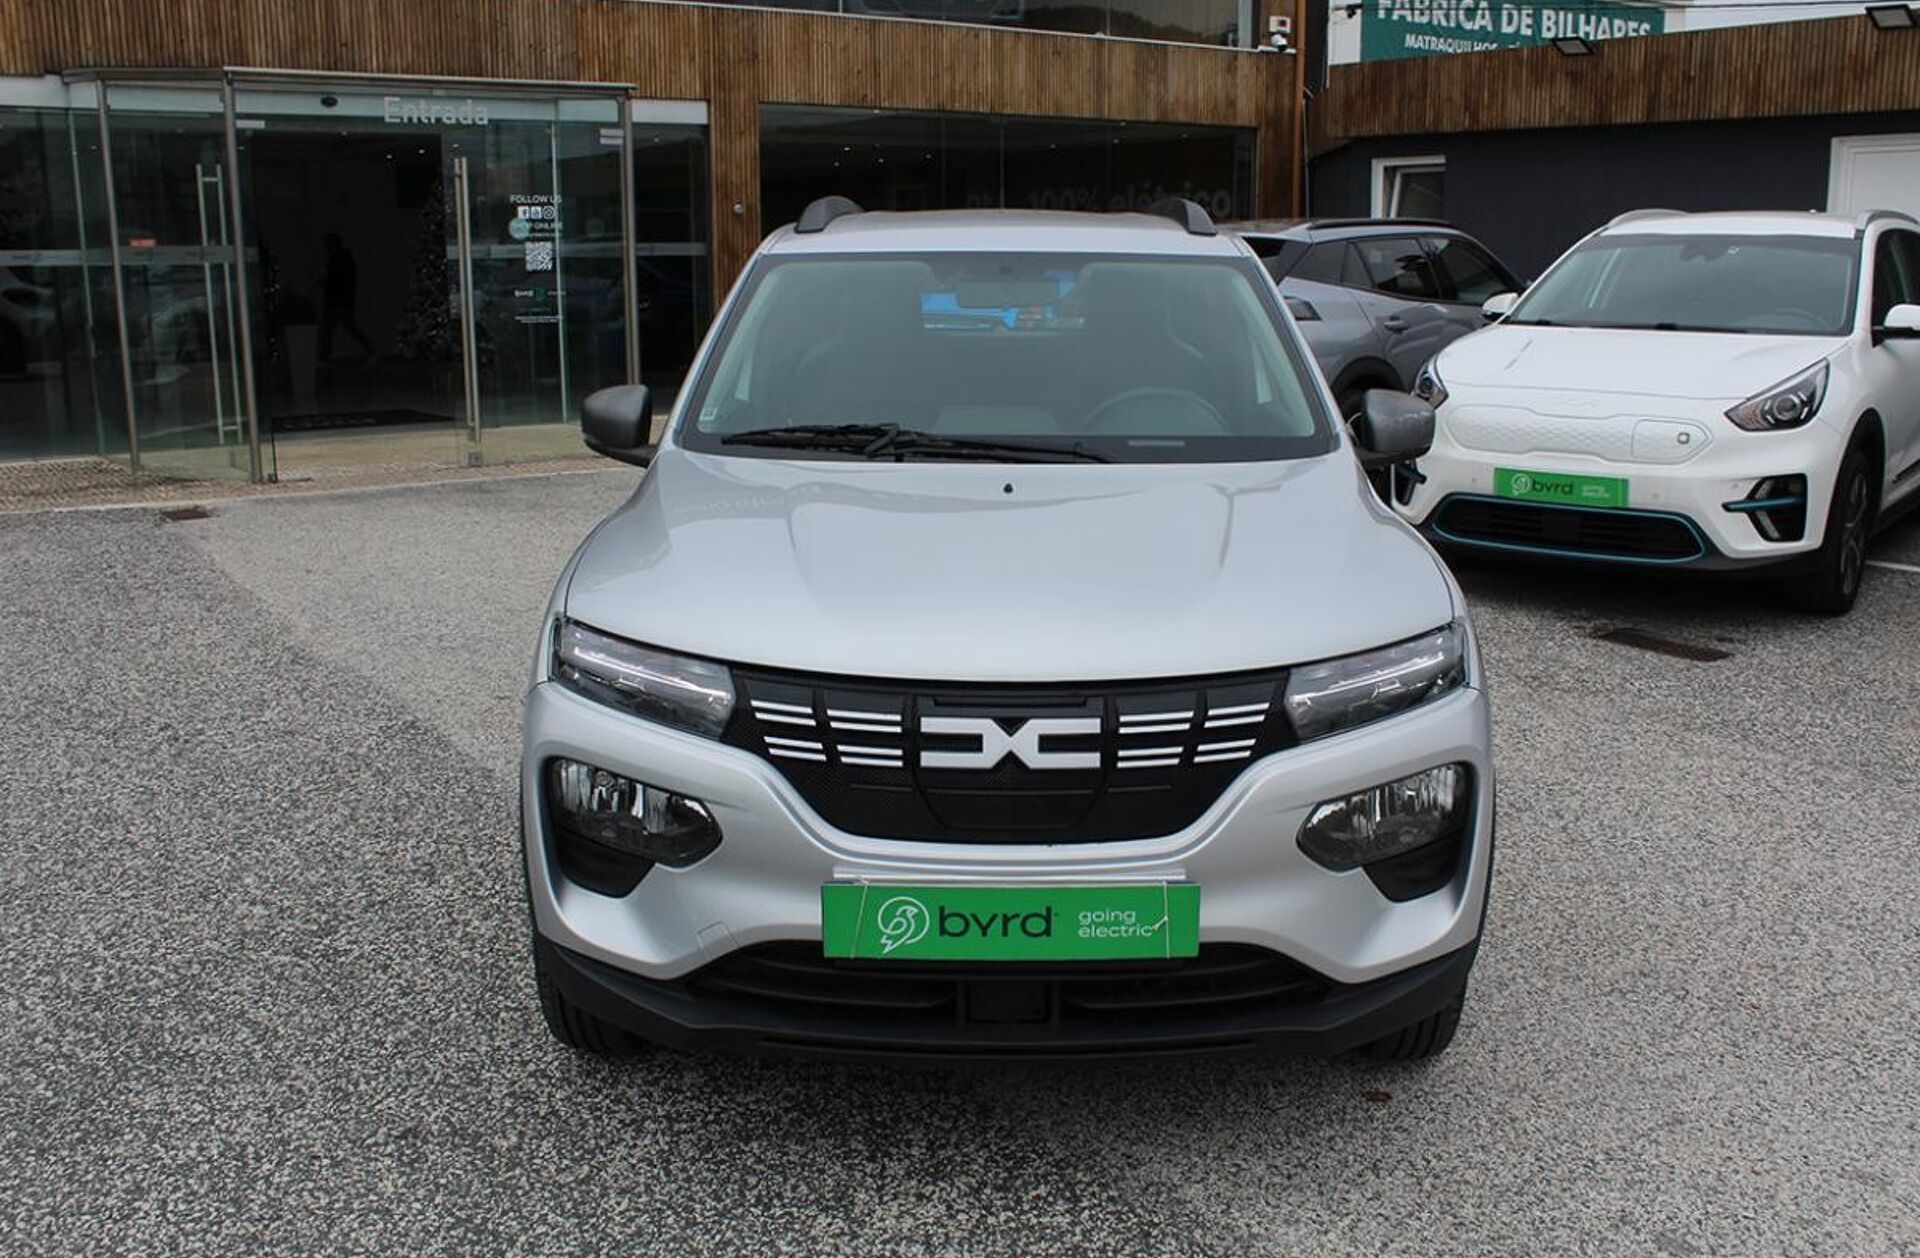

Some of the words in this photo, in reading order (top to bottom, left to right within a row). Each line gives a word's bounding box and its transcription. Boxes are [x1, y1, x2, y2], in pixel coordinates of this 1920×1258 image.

[1501, 4, 1533, 36] DE
[1541, 8, 1650, 41] BILHARES
[384, 96, 489, 126] Entrada
[510, 194, 548, 203] FOLLOW
[1532, 478, 1573, 495] byrd
[938, 905, 1052, 937] byrd
[1078, 908, 1136, 925] going
[1078, 923, 1153, 938] electric
